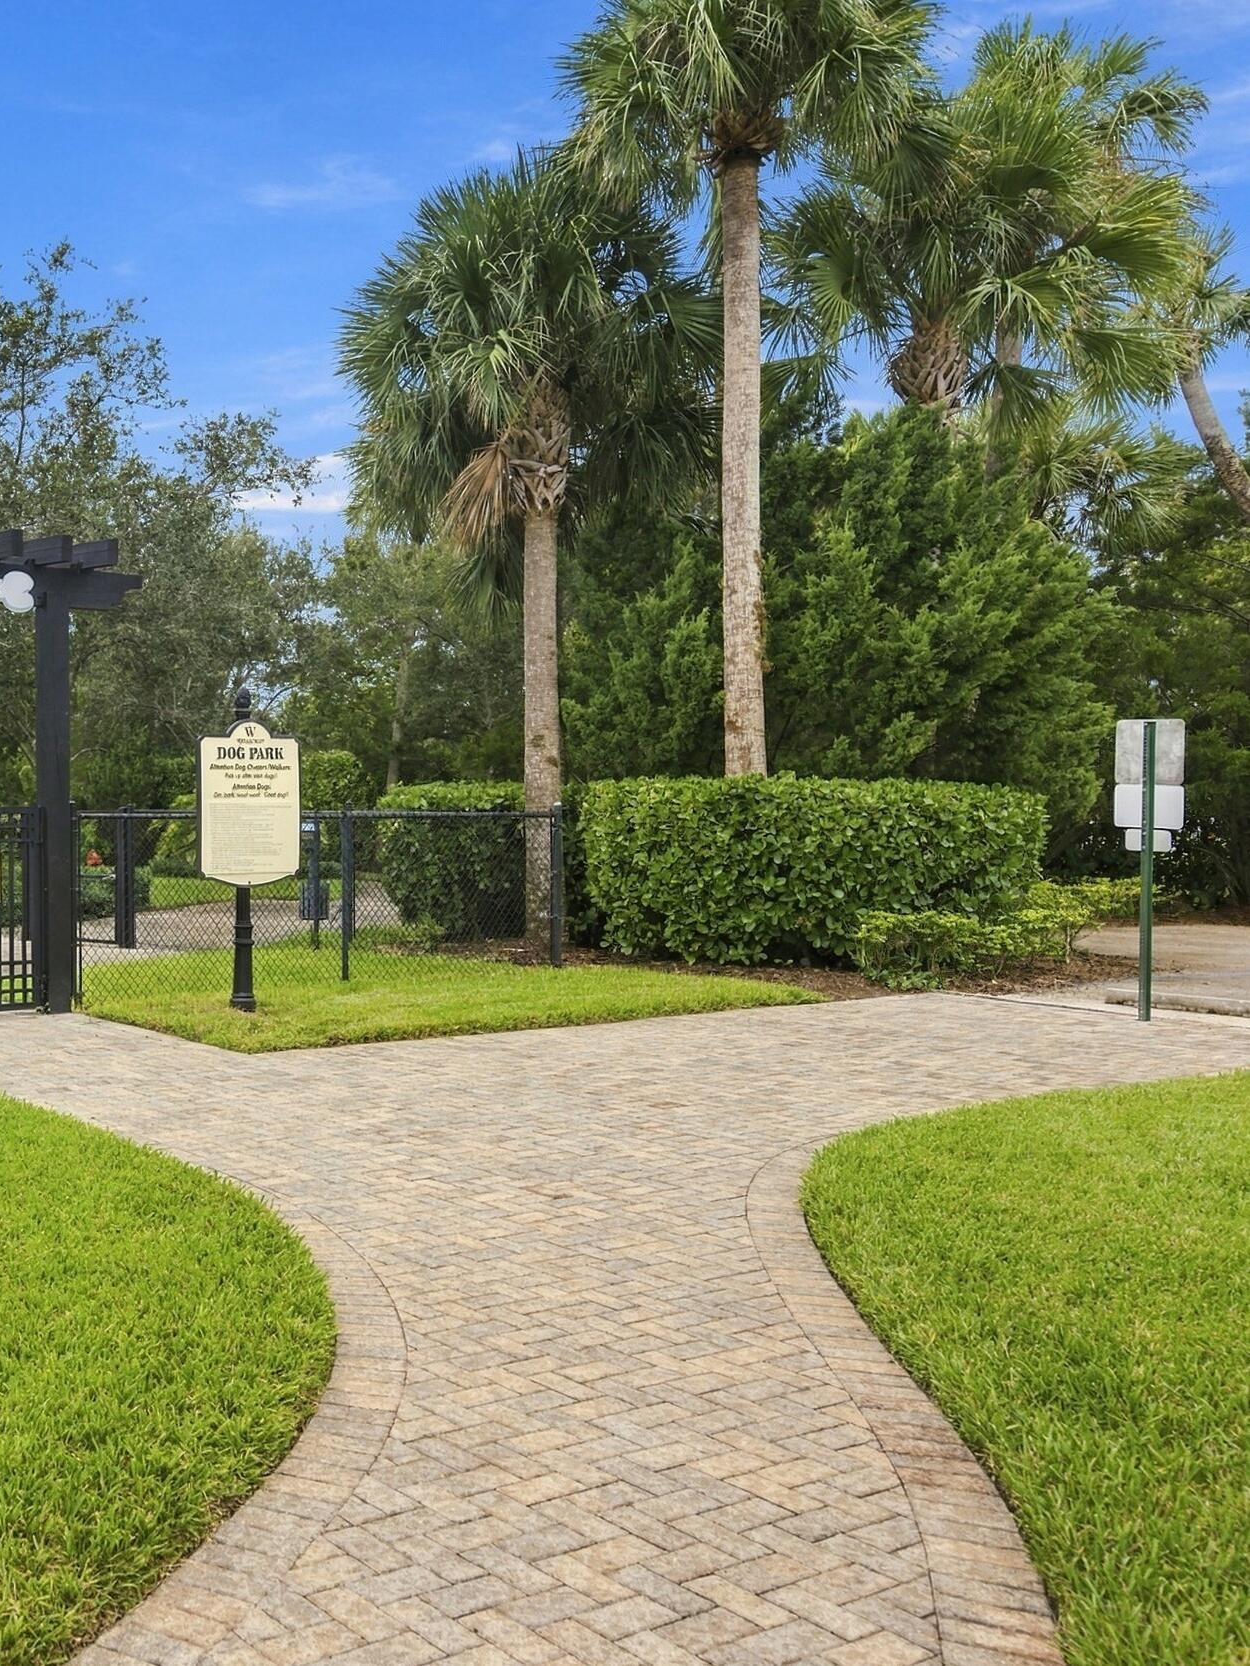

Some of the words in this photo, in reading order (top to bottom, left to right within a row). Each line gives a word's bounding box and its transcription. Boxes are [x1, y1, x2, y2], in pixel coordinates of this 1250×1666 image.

[245, 726, 256, 737] W
[217, 746, 245, 760] DOG
[250, 747, 284, 760] PARK
[209, 763, 234, 771] Attention
[235, 763, 246, 771] Dog
